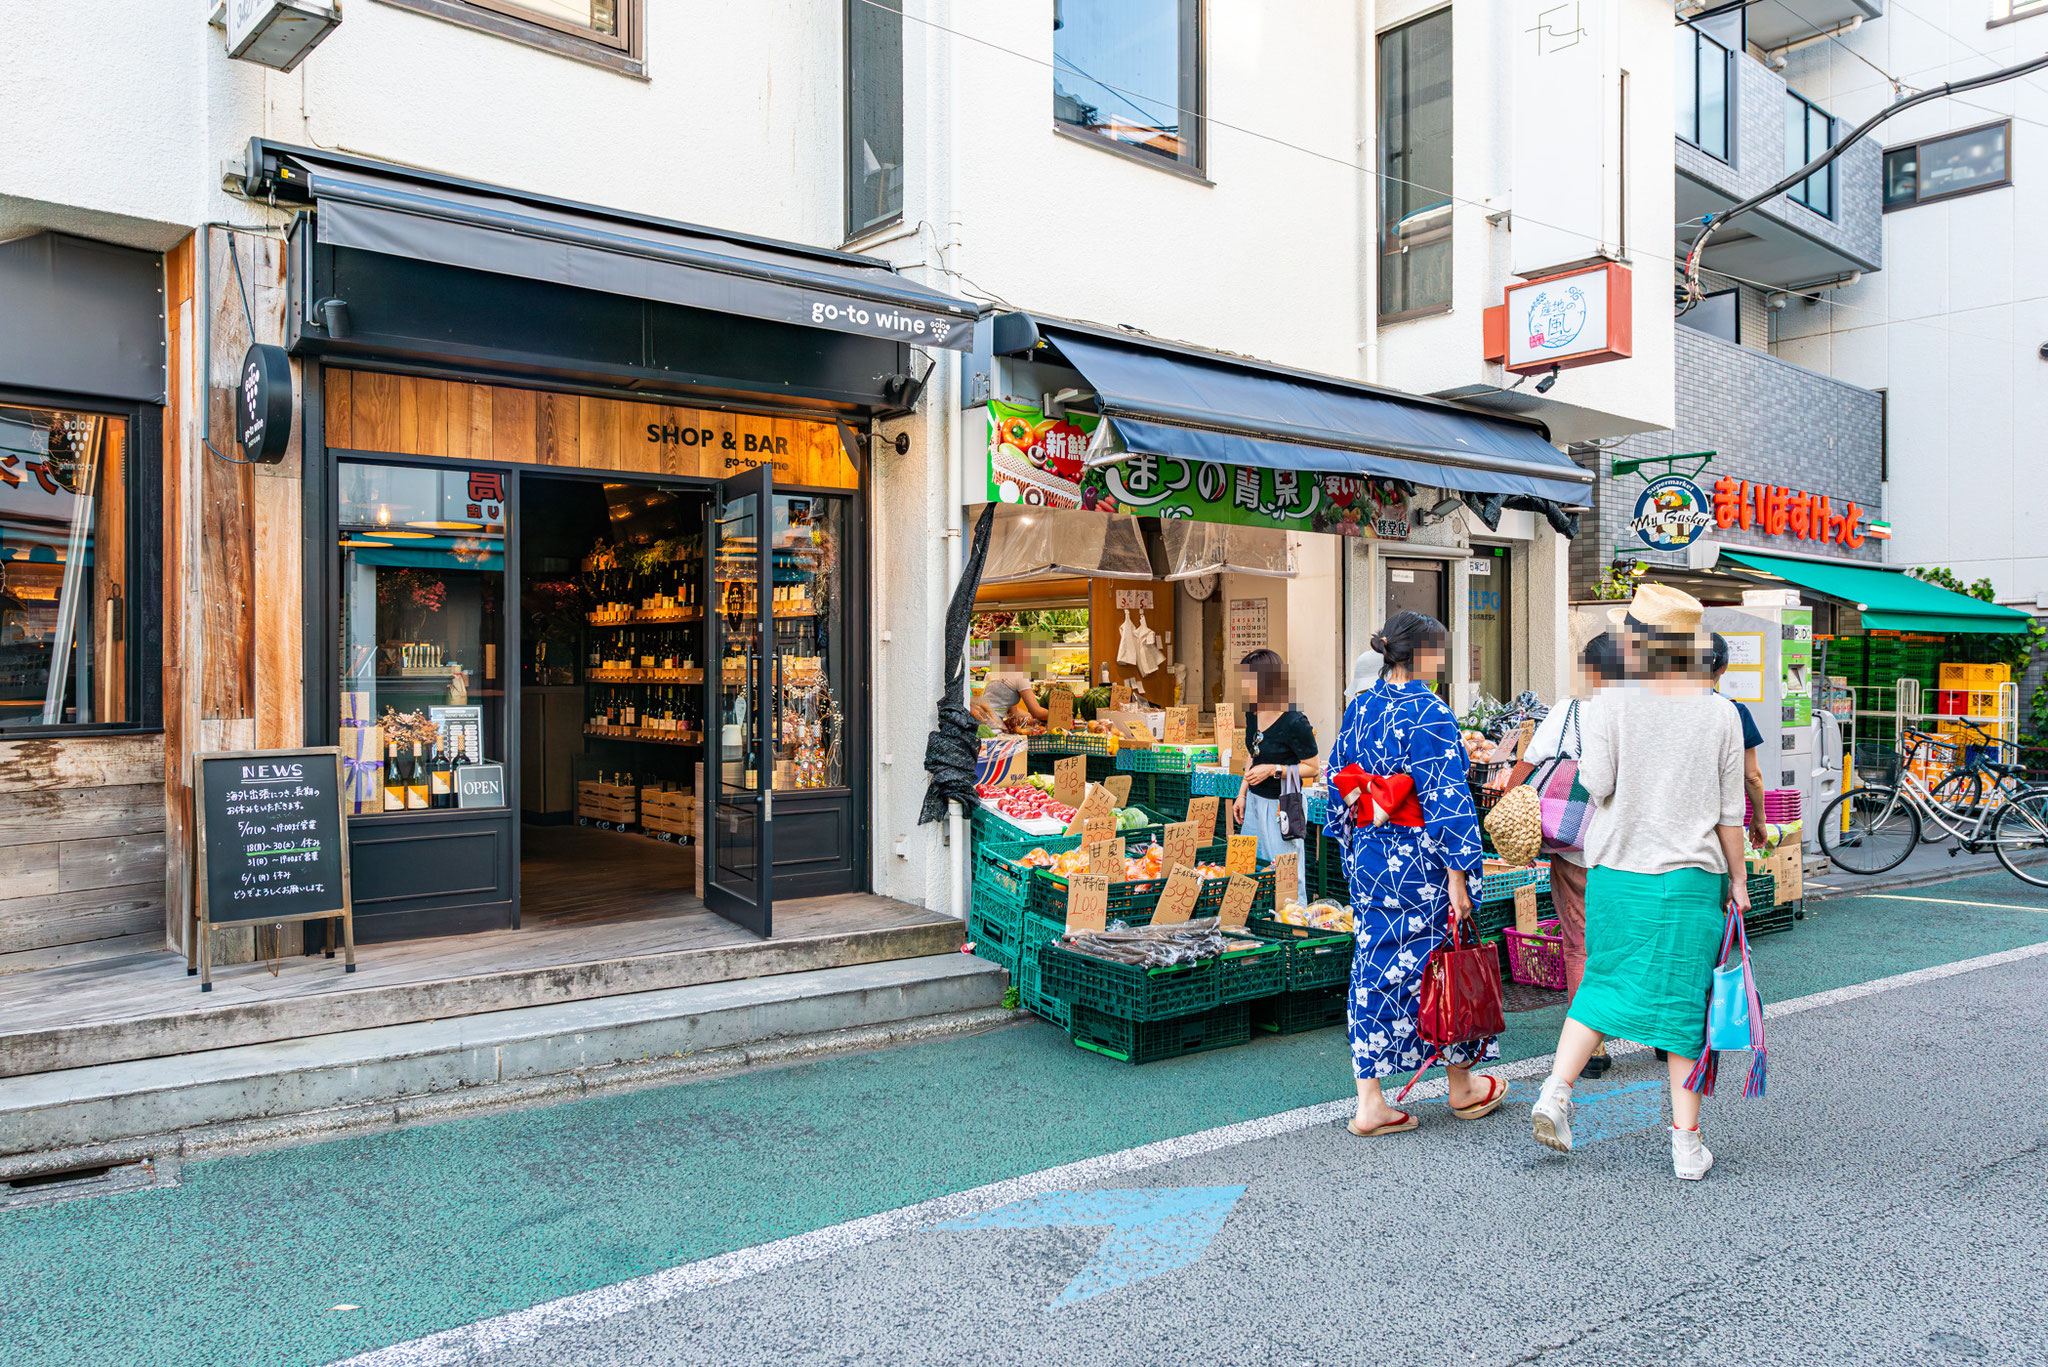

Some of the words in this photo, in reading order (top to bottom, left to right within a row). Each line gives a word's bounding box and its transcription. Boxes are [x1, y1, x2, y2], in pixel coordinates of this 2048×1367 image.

[812, 302, 870, 325] go-to
[874, 310, 926, 334] wine
[1548, 313, 1572, 336] 風
[647, 424, 714, 447] SHOP
[721, 432, 736, 451] &
[744, 434, 789, 456] BAR
[1046, 430, 1093, 461] 新鮮
[725, 457, 758, 469] go-to
[1127, 455, 1300, 510] まつの青果
[1646, 479, 1695, 495] Supermarket
[1630, 513, 1658, 532] My
[1664, 509, 1711, 527] Basket
[1713, 475, 1866, 549] まいばすけっと
[1377, 519, 1407, 537] 経堂店
[242, 764, 303, 778] NEWS
[464, 780, 499, 796] OPEN
[1093, 787, 1110, 804] トマト
[1167, 825, 1193, 840] オレンジ
[301, 837, 320, 848] 休み
[1091, 841, 1120, 858] 甘夏
[1277, 854, 1297, 868] バナナ
[272, 870, 291, 880] 休み
[1073, 876, 1106, 891] 大特価
[1164, 880, 1196, 908] 398
[1225, 889, 1252, 913] 398
